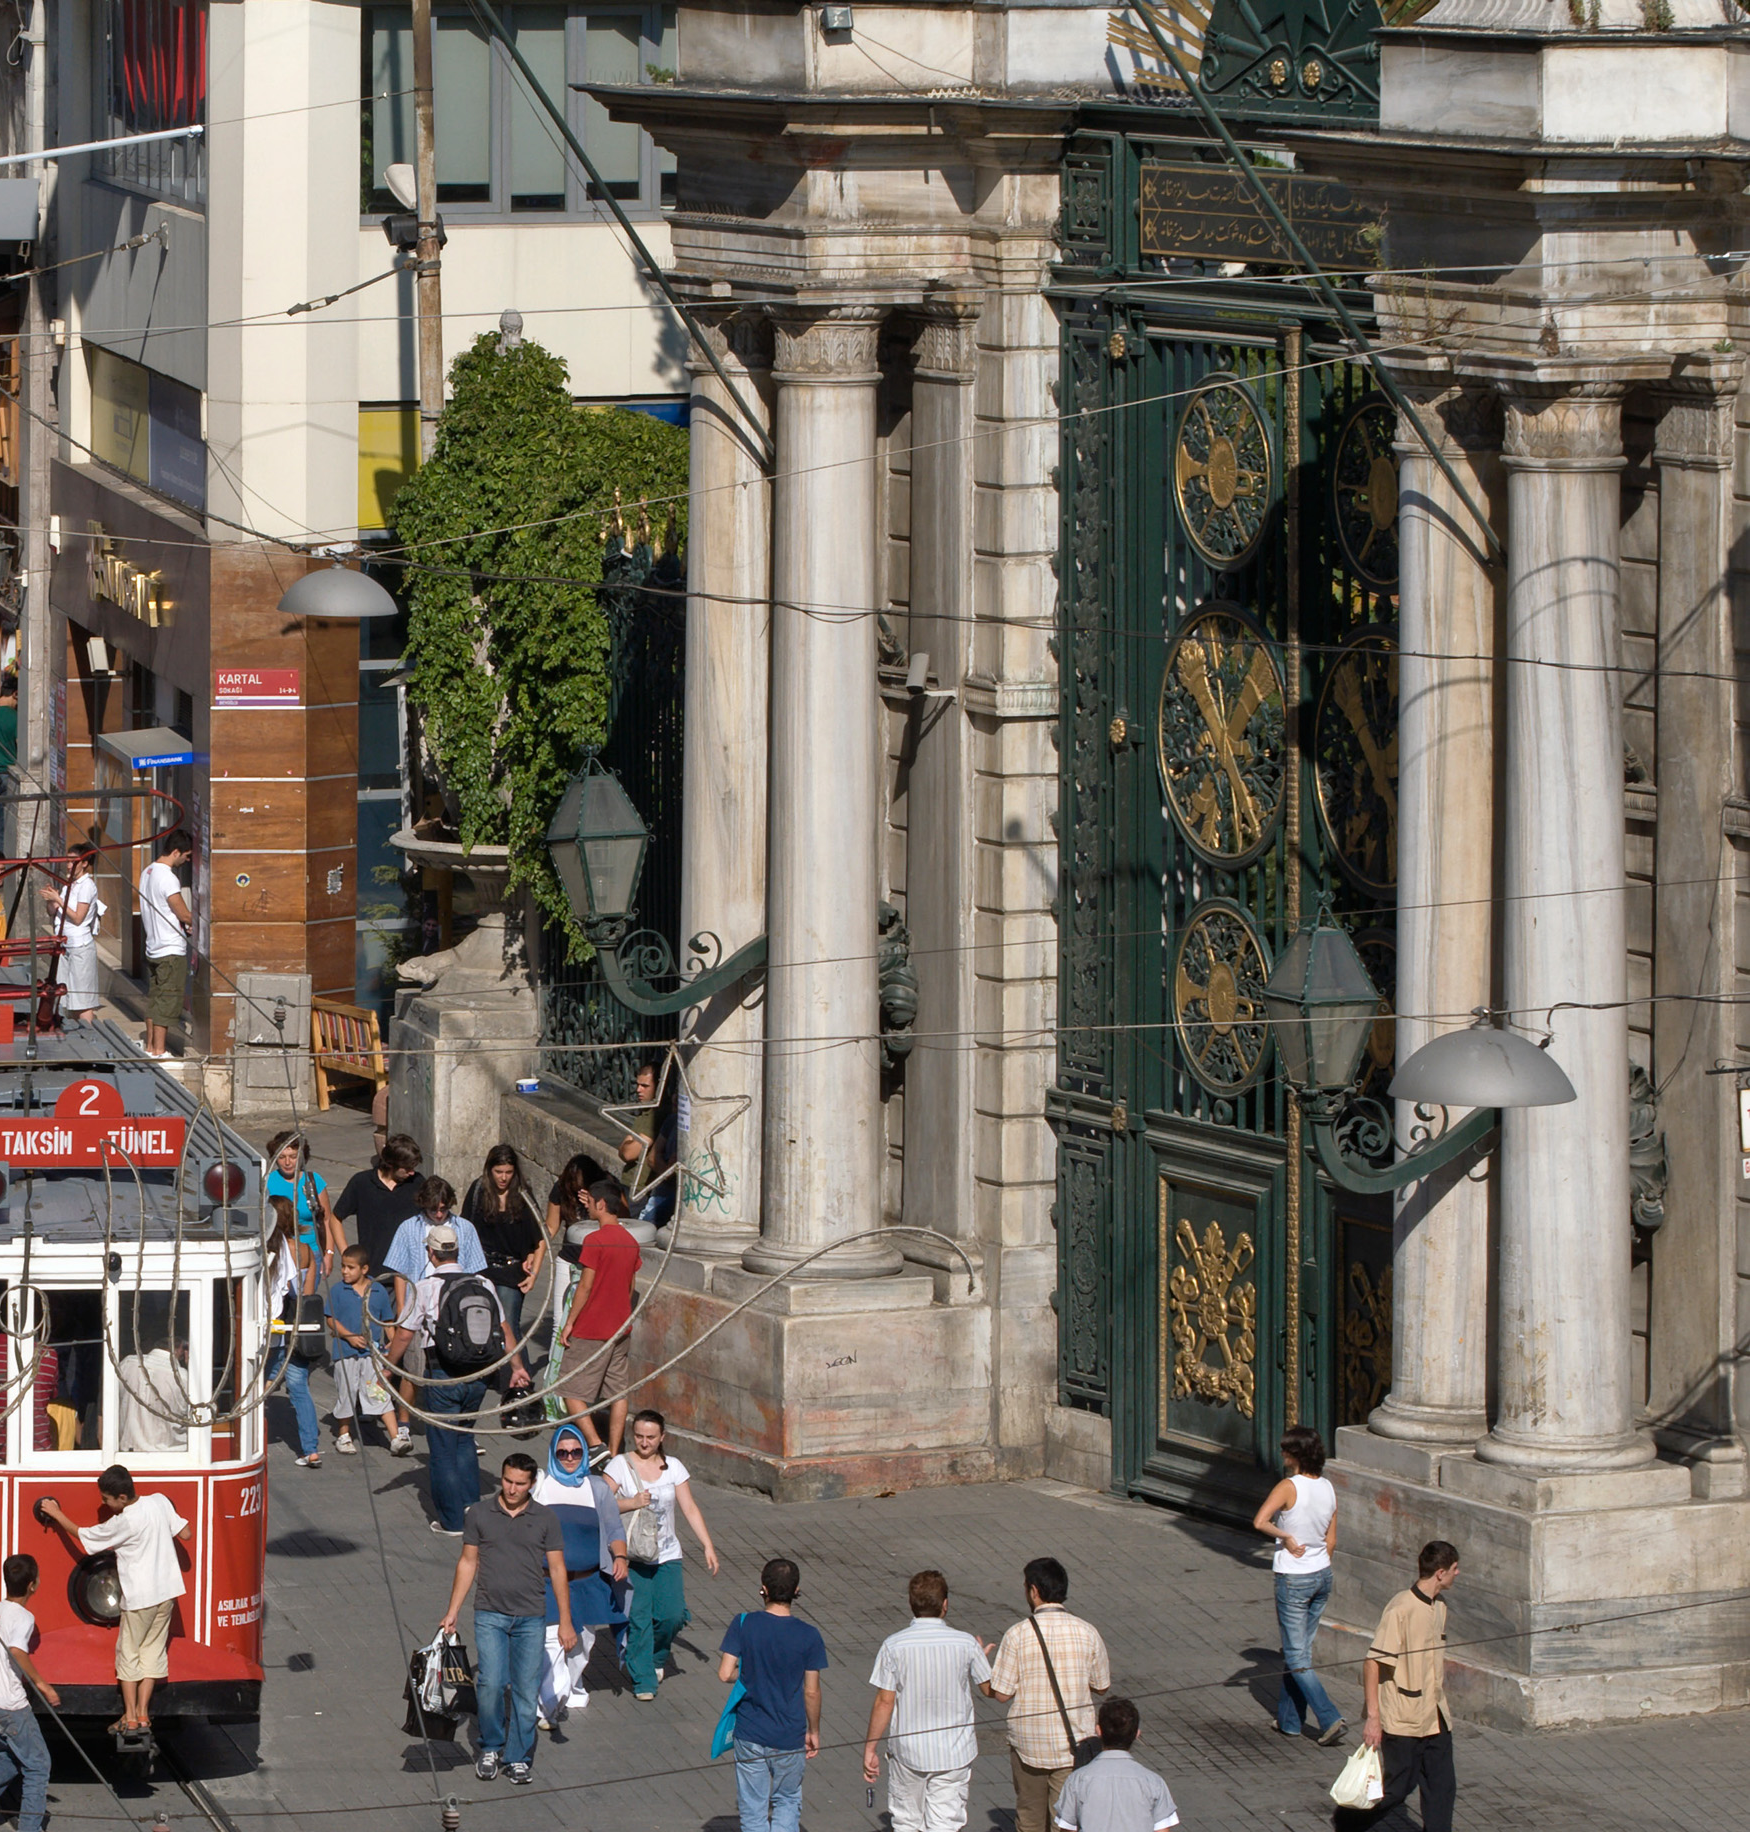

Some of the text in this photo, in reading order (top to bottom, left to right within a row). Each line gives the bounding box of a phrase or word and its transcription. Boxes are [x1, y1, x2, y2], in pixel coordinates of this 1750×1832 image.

[218, 673, 263, 685] KARTAL
[79, 1084, 100, 1116] 2
[1, 1126, 73, 1155] TAKSİM
[107, 1126, 174, 1155] TÜNEL
[240, 1483, 261, 1517] 223
[217, 1597, 248, 1612] ASILMAK
[217, 1615, 229, 1627] VE
